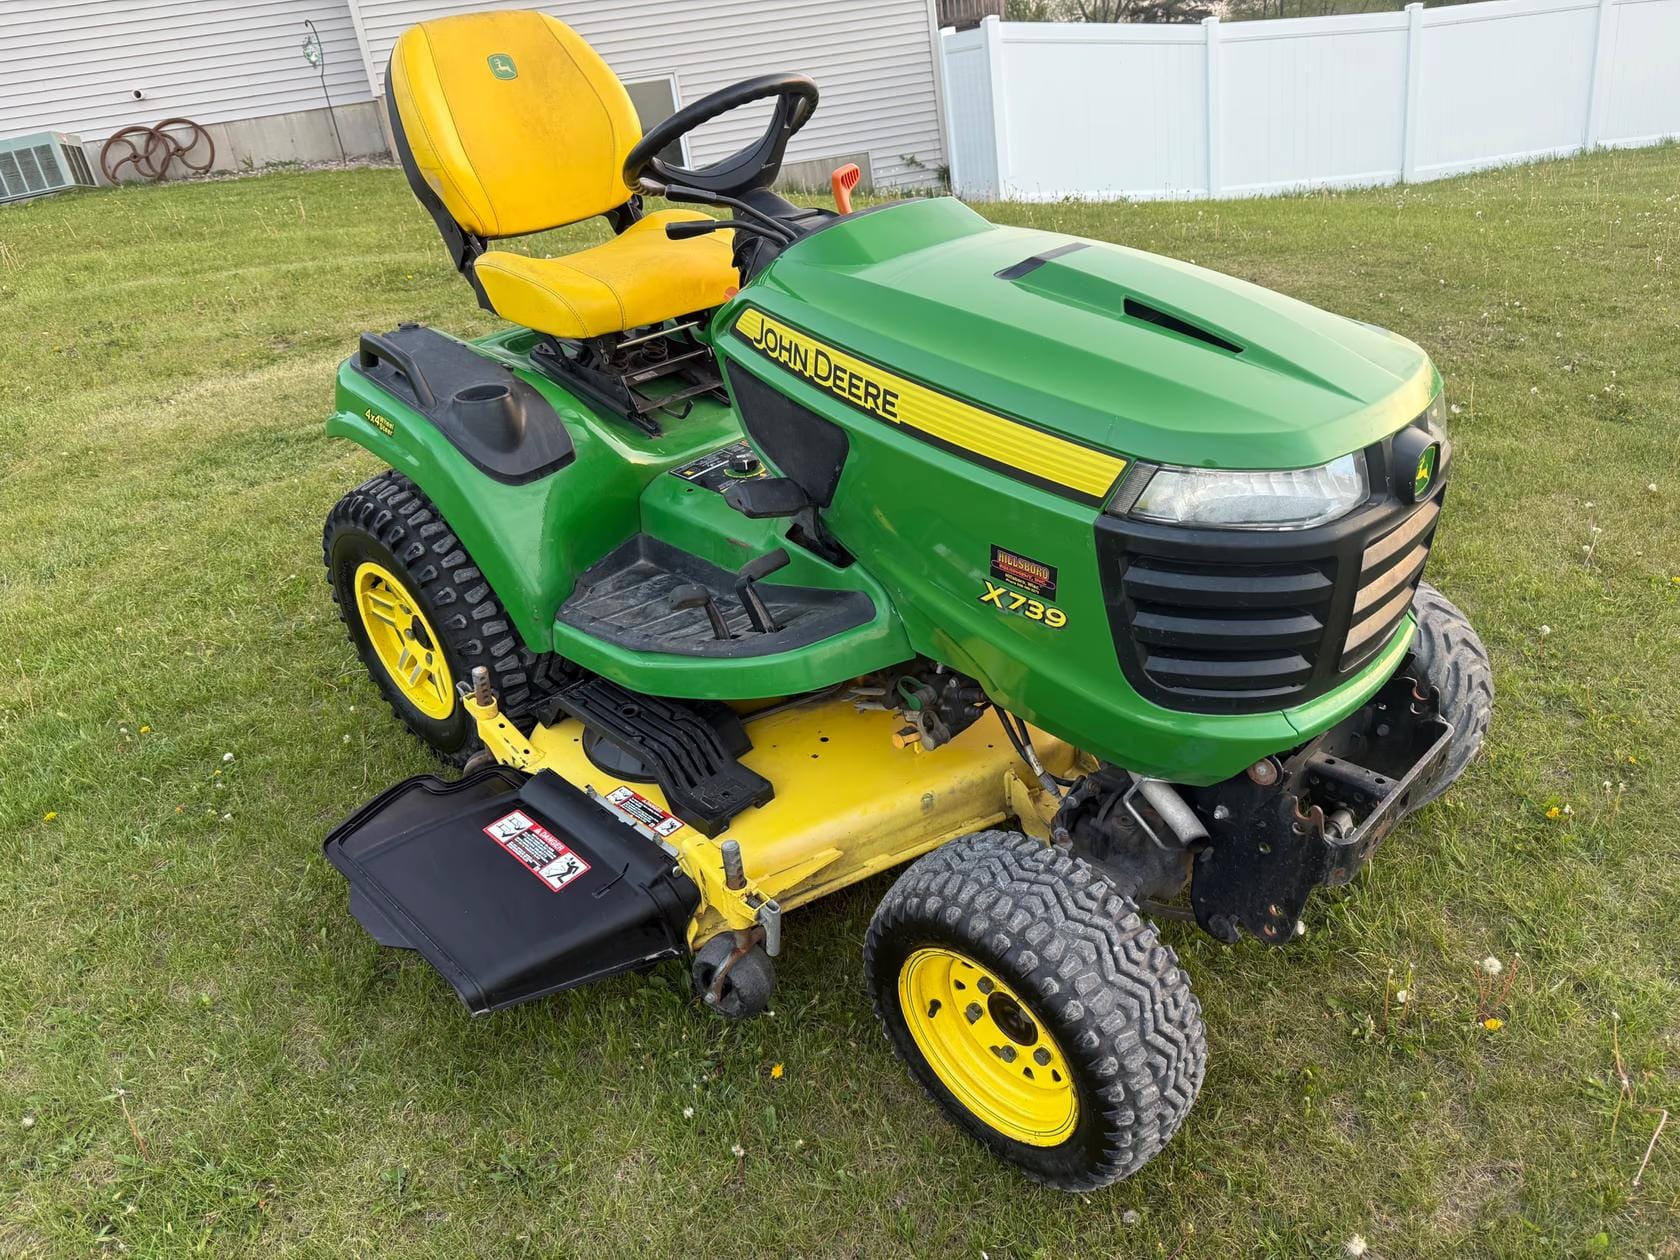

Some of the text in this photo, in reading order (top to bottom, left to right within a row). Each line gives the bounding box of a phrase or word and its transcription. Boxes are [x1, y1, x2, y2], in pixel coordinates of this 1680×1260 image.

[753, 318, 899, 418] JOHN DEERE
[997, 549, 1050, 580] HILLSBORO
[980, 579, 1068, 628] X739
[540, 830, 566, 852] DANGER
